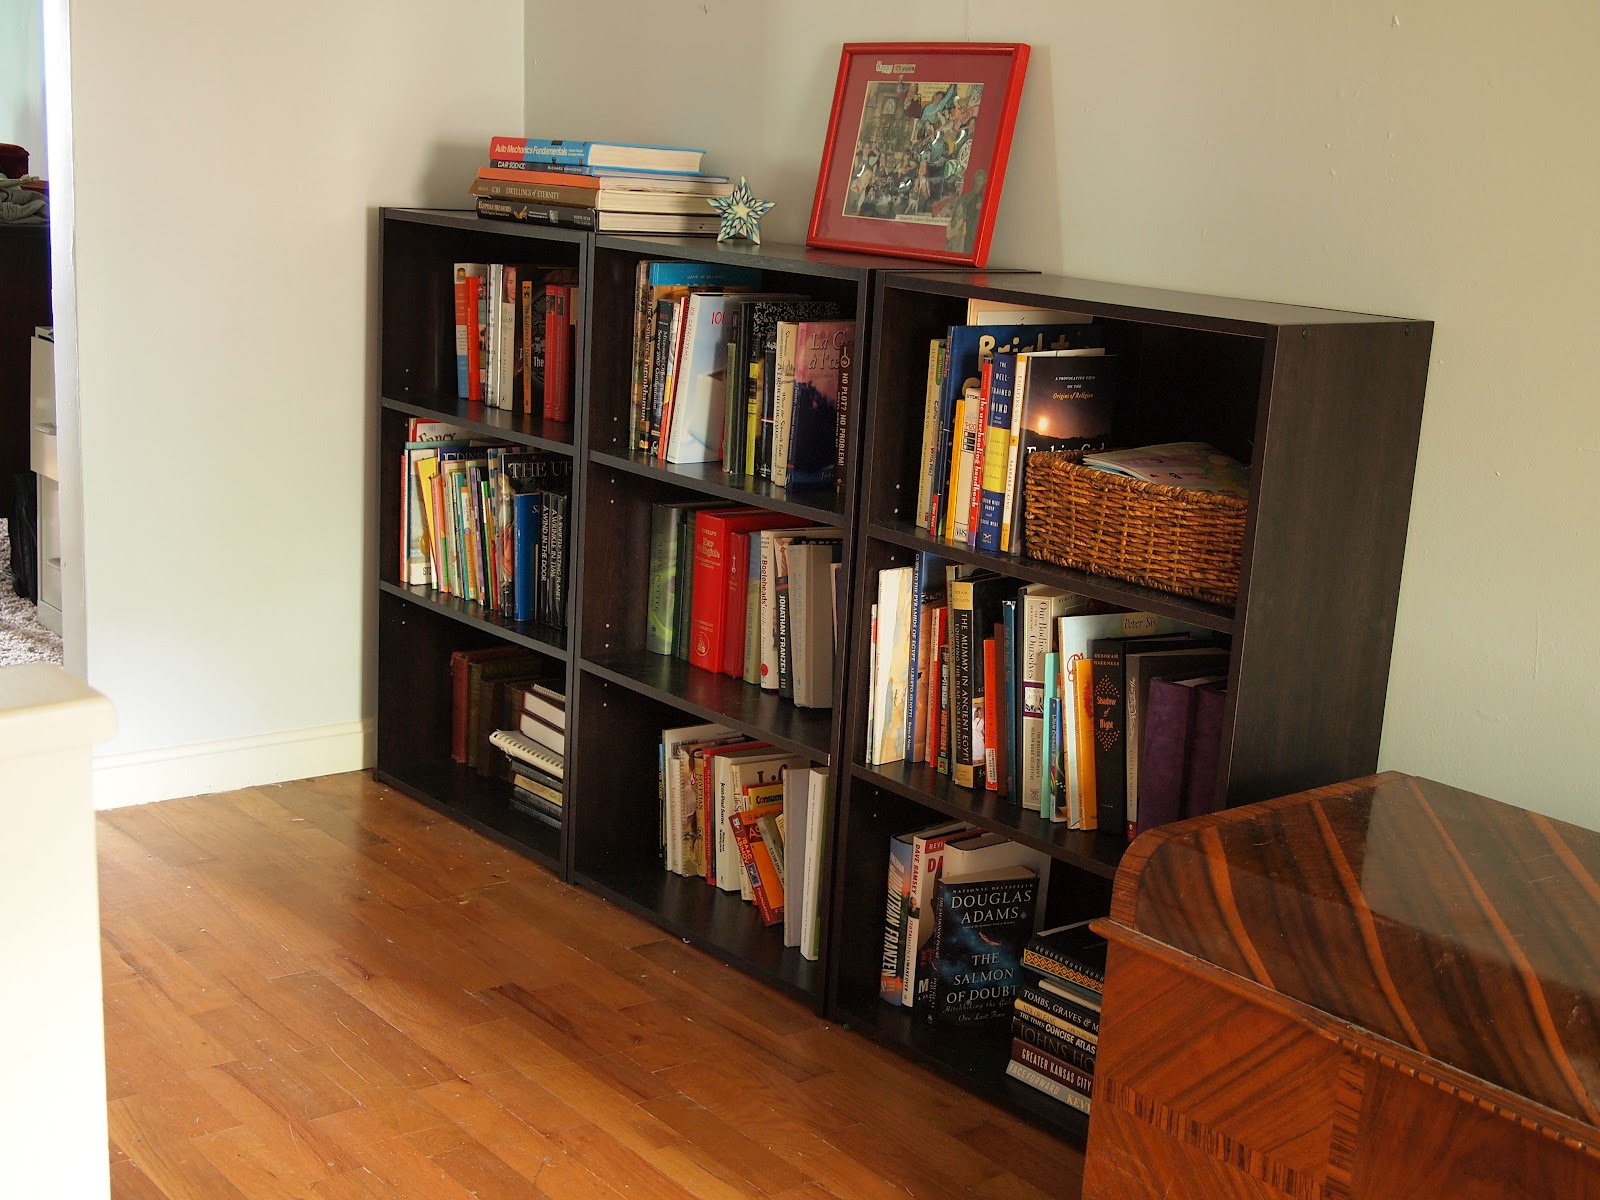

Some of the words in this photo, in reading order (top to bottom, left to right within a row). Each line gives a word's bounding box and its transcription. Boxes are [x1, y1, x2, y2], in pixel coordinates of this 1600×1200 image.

[495, 144, 506, 154] Auto
[507, 145, 533, 156] Mechanics
[533, 146, 568, 156] Fundamentals
[506, 187, 532, 196] DWELLINGS
[537, 190, 560, 200] ETERNITY
[712, 311, 726, 325] 101
[645, 318, 653, 356] Complete
[683, 319, 693, 361] CATACLYSMS
[810, 333, 829, 350] La
[999, 361, 1007, 369] THE
[842, 372, 848, 384] NO
[996, 372, 1010, 382] WELL-
[640, 356, 650, 421] Tutankhamun
[992, 386, 1012, 397] TRAINED
[1052, 392, 1069, 400] Origins
[1069, 391, 1076, 400] of
[1076, 392, 1093, 400] Religion
[840, 386, 848, 411] PLOT?
[992, 402, 1008, 414] MIND
[840, 414, 846, 426] NO
[926, 420, 930, 428] CD
[974, 411, 986, 464] unschooling
[838, 428, 846, 466] PROBLEM!
[508, 462, 547, 479] THE
[971, 466, 980, 508] handbook
[542, 535, 548, 543] IN
[956, 526, 967, 538] VHS
[550, 550, 556, 558] IN
[760, 560, 768, 607] Bogleheads'
[914, 573, 919, 581] TO
[654, 574, 662, 612] POTTER
[1038, 602, 1047, 619] Our
[1124, 618, 1142, 629] Peter
[912, 629, 917, 639] OF
[1037, 621, 1048, 656] Bodies,
[961, 634, 969, 672] MUMMY
[1028, 635, 1037, 679] Ourselves
[962, 675, 969, 686] IN
[1096, 696, 1117, 706] Shadow
[961, 690, 969, 731] ANCIENT
[1103, 707, 1110, 717] of
[1099, 718, 1114, 731] Night
[988, 730, 997, 743] life
[736, 837, 750, 864] ASIMOV
[742, 837, 752, 860] ISAAC
[774, 863, 782, 874] SPACE
[757, 887, 770, 922] FOUNDATION
[885, 867, 903, 928] JONATHAN
[951, 890, 1032, 909] DOUGLAS
[961, 907, 1019, 924] ADAMS
[882, 926, 900, 977] FRANZEN
[971, 952, 1000, 966] THE
[954, 968, 1014, 986] SALMON
[946, 990, 966, 1004] OF
[969, 985, 1019, 1001] DOUBT
[943, 1002, 984, 1013] Hitchhiking
[986, 1000, 996, 1008] the
[1023, 989, 1051, 1011] TOMBS,
[1052, 1004, 1082, 1024] GRAVES
[1083, 1017, 1091, 1028] &
[1023, 1005, 1034, 1015] NEW
[1033, 1009, 1057, 1024] ORLEANS
[958, 1014, 971, 1022] One
[975, 1012, 989, 1020] Last
[991, 1010, 1005, 1018] Time
[1019, 1012, 1030, 1022] THE
[1030, 1016, 1045, 1029] TIMES
[1045, 1024, 1075, 1044] CONCISE
[1075, 1039, 1096, 1055] ATLAS
[1020, 1024, 1068, 1058] JOHNS
[1022, 1048, 1048, 1070] GREATER
[1050, 1062, 1075, 1084] KANSAS
[1076, 1075, 1092, 1092] CITY
[1008, 1063, 1026, 1078] FACE
[1026, 1072, 1060, 1095] FORWARD
